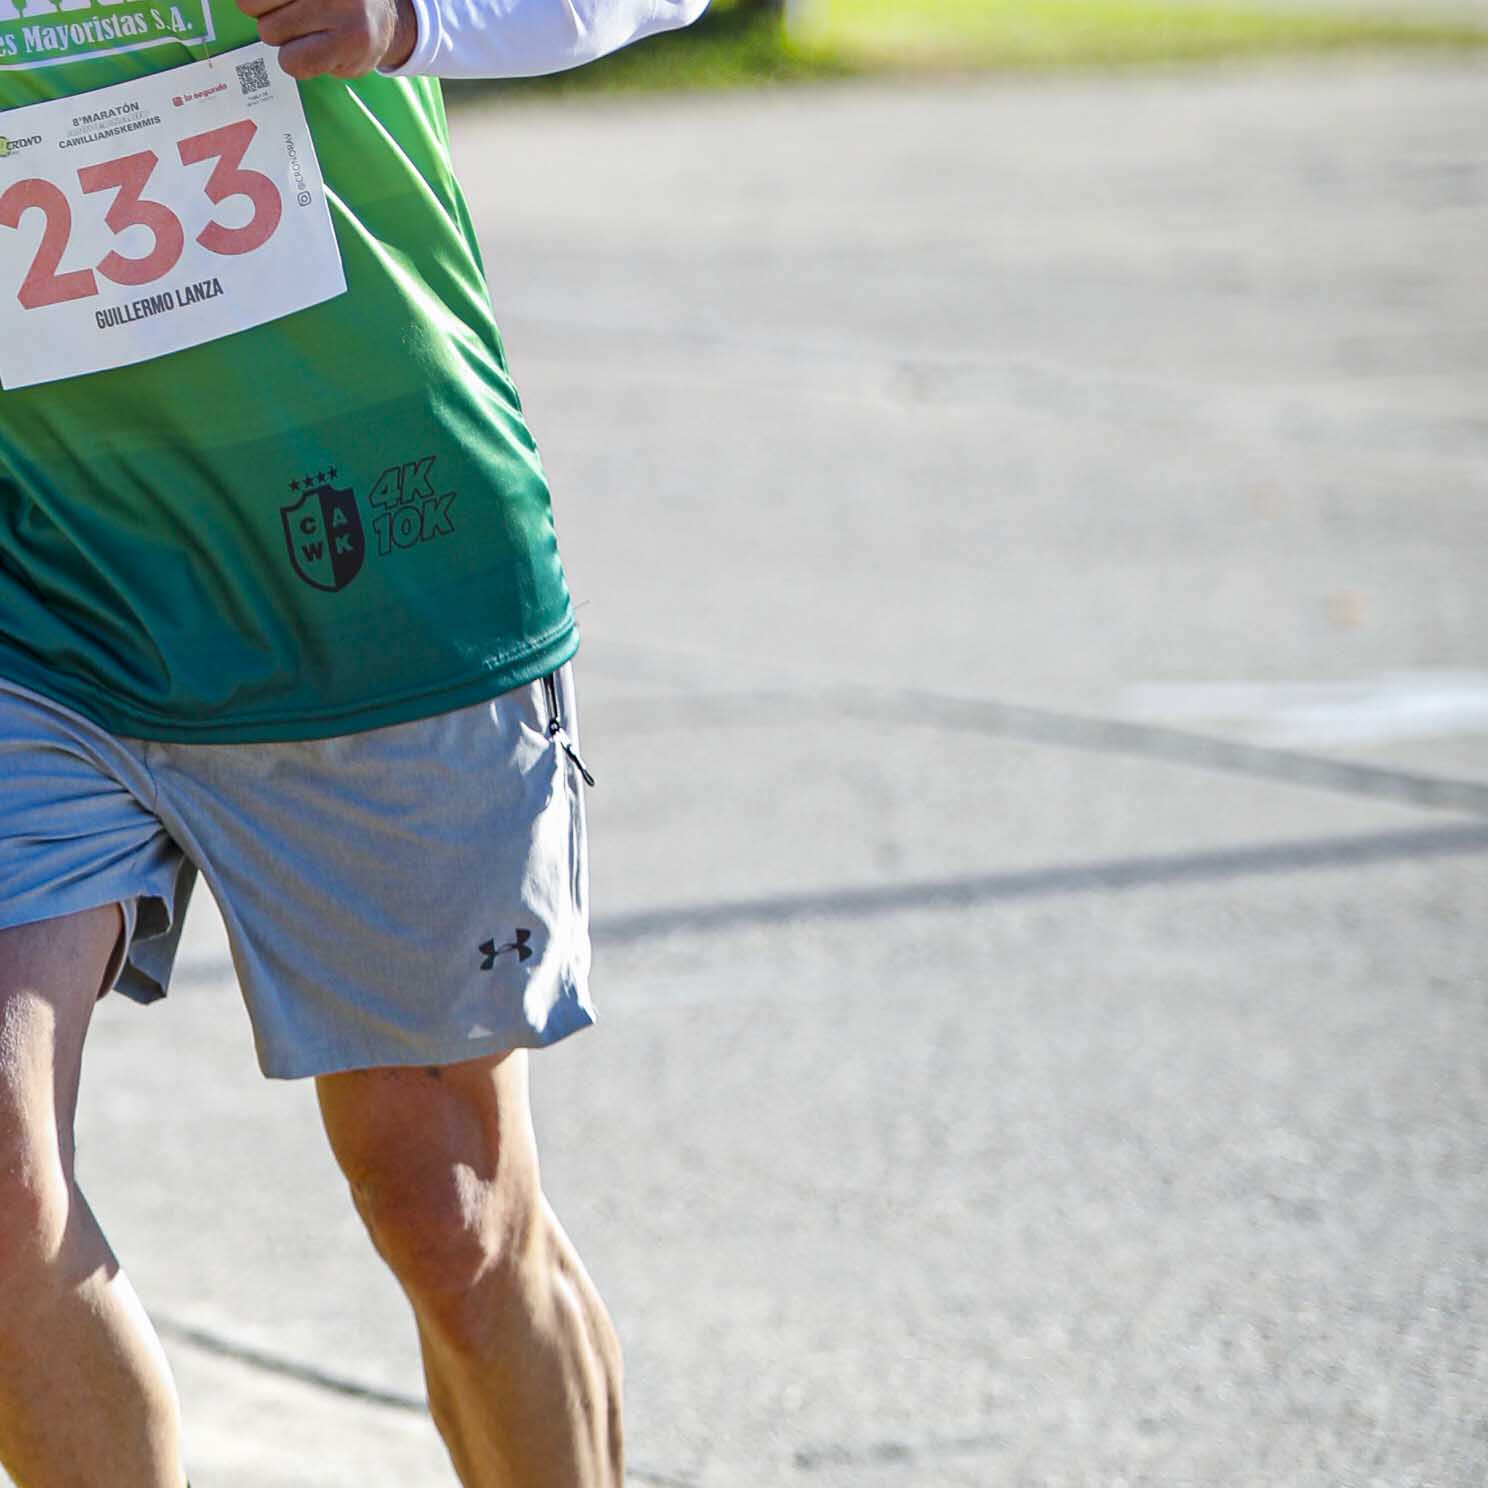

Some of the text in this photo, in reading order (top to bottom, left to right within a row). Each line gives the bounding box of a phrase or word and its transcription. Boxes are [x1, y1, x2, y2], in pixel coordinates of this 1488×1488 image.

[23, 10, 148, 55] Mayoristas
[58, 115, 162, 150] CAWILLIAMSKEMMIS
[95, 277, 224, 330] GUILLERMO LANZA
[369, 455, 437, 510] 4K
[372, 491, 457, 557] 10K
